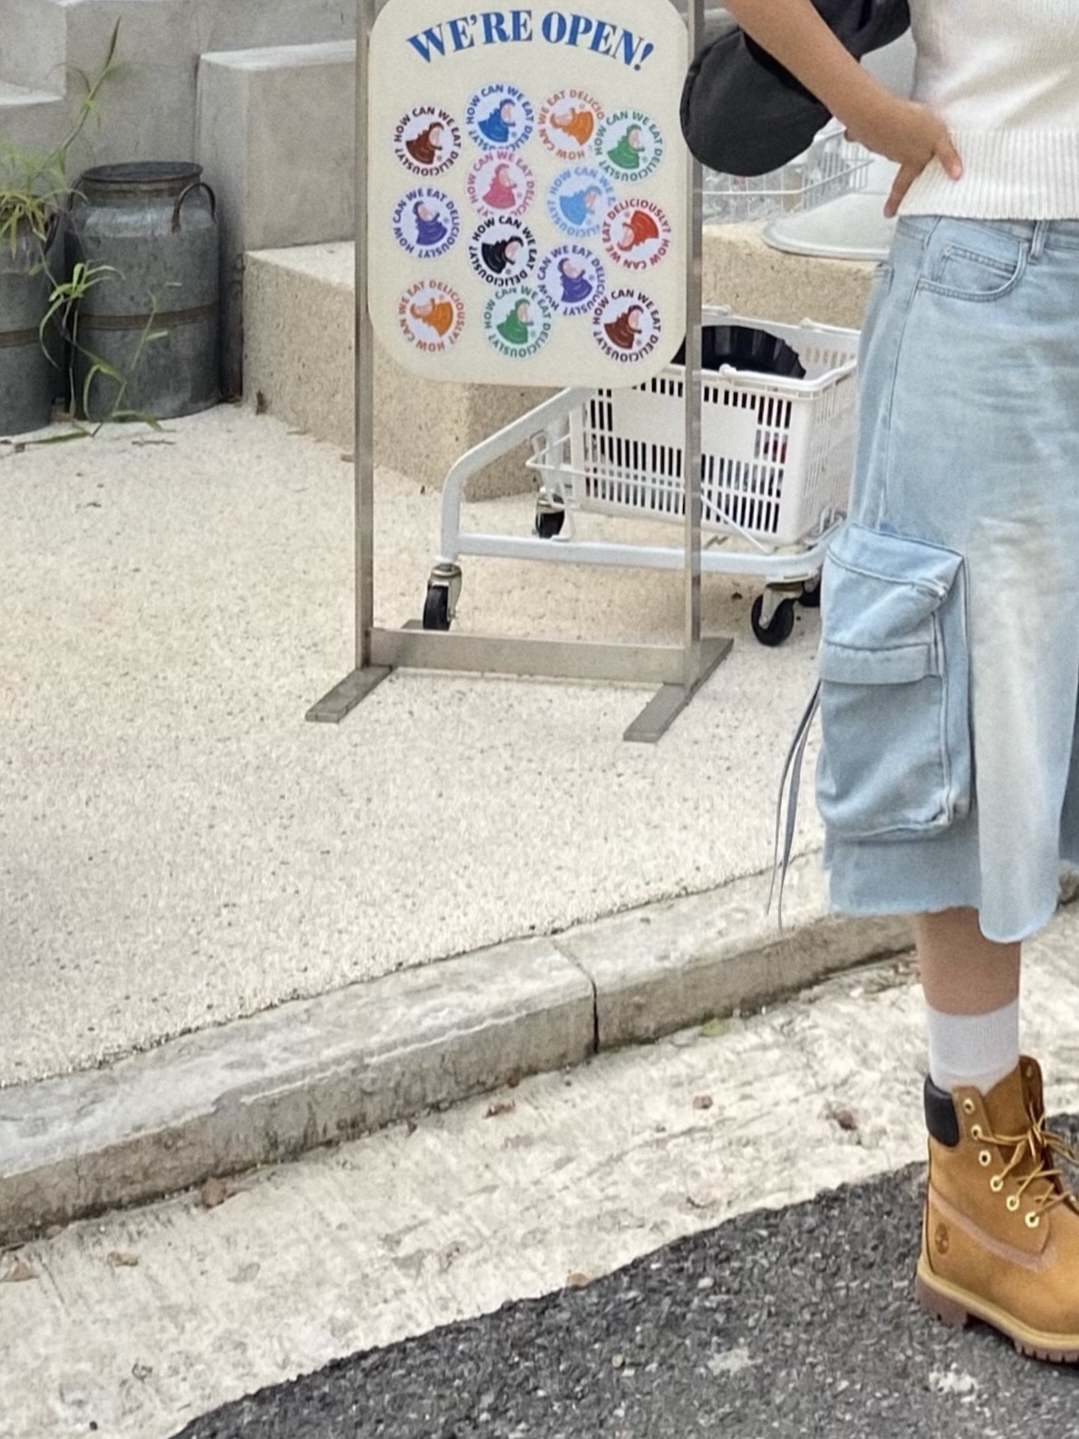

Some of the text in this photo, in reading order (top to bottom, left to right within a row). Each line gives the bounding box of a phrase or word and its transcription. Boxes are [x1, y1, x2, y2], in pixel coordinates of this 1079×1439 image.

[406, 10, 654, 71] WE'RE OPEN!
[466, 95, 480, 124] HOW
[481, 84, 504, 97] CAN
[508, 86, 525, 101] WE
[522, 101, 534, 122] EAT
[547, 90, 565, 106] EAT
[538, 106, 550, 124] WE
[394, 114, 410, 142] HOW
[412, 106, 435, 117] CAN
[438, 109, 455, 126] WE
[451, 127, 461, 148] EAT
[594, 125, 606, 155] HOW
[606, 111, 628, 125] CAN
[632, 111, 650, 125] WE
[649, 124, 663, 144] EAT
[538, 129, 555, 151] CAN
[467, 173, 478, 204] HOW
[473, 153, 494, 172] CAN
[497, 151, 514, 162] WE
[516, 158, 533, 176] EAT
[550, 170, 571, 195] HOW
[574, 167, 598, 179] CAN
[406, 188, 424, 201] WE
[427, 188, 447, 202] EAT
[393, 200, 407, 223] CAN
[499, 216, 522, 229] CAN
[393, 227, 414, 253] HOW
[472, 217, 495, 241] HOW
[522, 227, 535, 246] WE
[602, 221, 611, 242] EAT
[526, 249, 537, 270] EAT
[537, 257, 552, 280] CAN
[551, 245, 569, 258] WE
[572, 245, 592, 258] EAT
[606, 244, 621, 262] WE
[650, 238, 670, 266] HOW
[623, 259, 647, 270] CAN
[407, 281, 424, 296] EAT
[399, 296, 410, 315] WE
[484, 299, 496, 329] HOW
[521, 285, 538, 300] WE
[537, 298, 551, 318] EAT
[593, 296, 609, 324] HOW
[611, 289, 634, 299] CAN
[638, 292, 654, 309] WE
[651, 310, 661, 332] EAT
[400, 319, 415, 341] CAN
[416, 340, 445, 352] HOW
